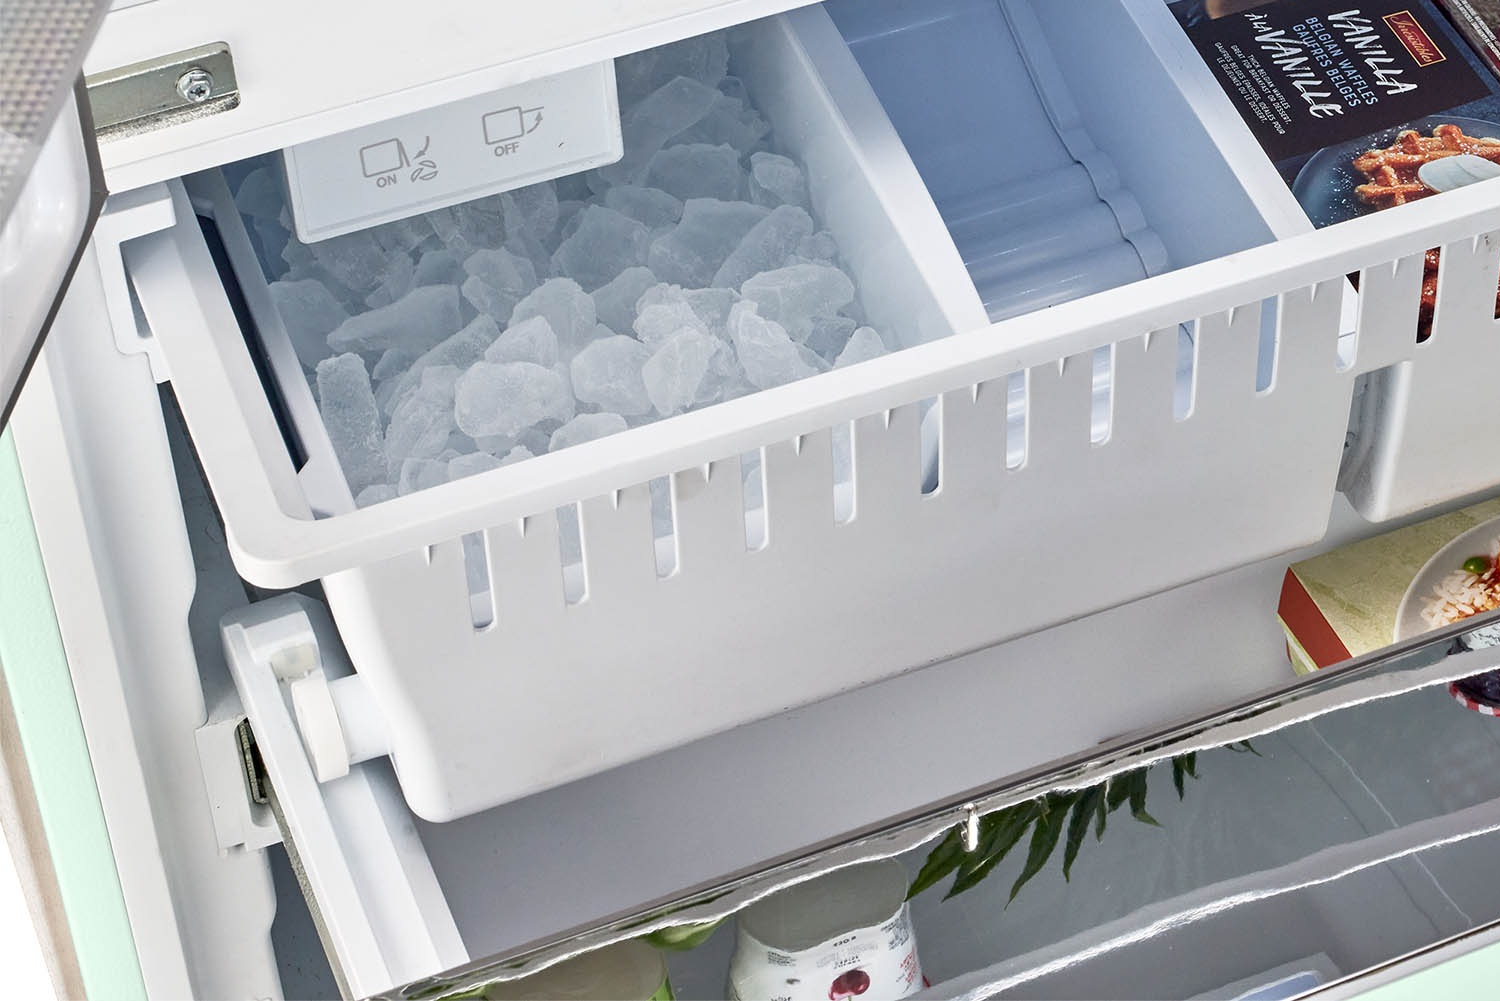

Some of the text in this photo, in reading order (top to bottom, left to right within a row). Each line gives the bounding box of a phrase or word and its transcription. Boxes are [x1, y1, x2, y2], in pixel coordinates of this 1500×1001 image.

[1253, 22, 1273, 33] LA
[1305, 16, 1378, 105] BELGIAN WAFFLES
[1327, 9, 1418, 95] VANILLA
[1214, 42, 1234, 63] GAUFRES
[1272, 121, 1286, 134] POUR
[1231, 44, 1245, 60] GREAT
[1248, 69, 1271, 95] BREAKFAST
[1255, 29, 1344, 119] VANILLE
[1273, 87, 1291, 110] WAFFLES
[1292, 24, 1361, 107] GAUFRES BELGES
[376, 174, 397, 188] ON
[494, 142, 520, 157] OFF
